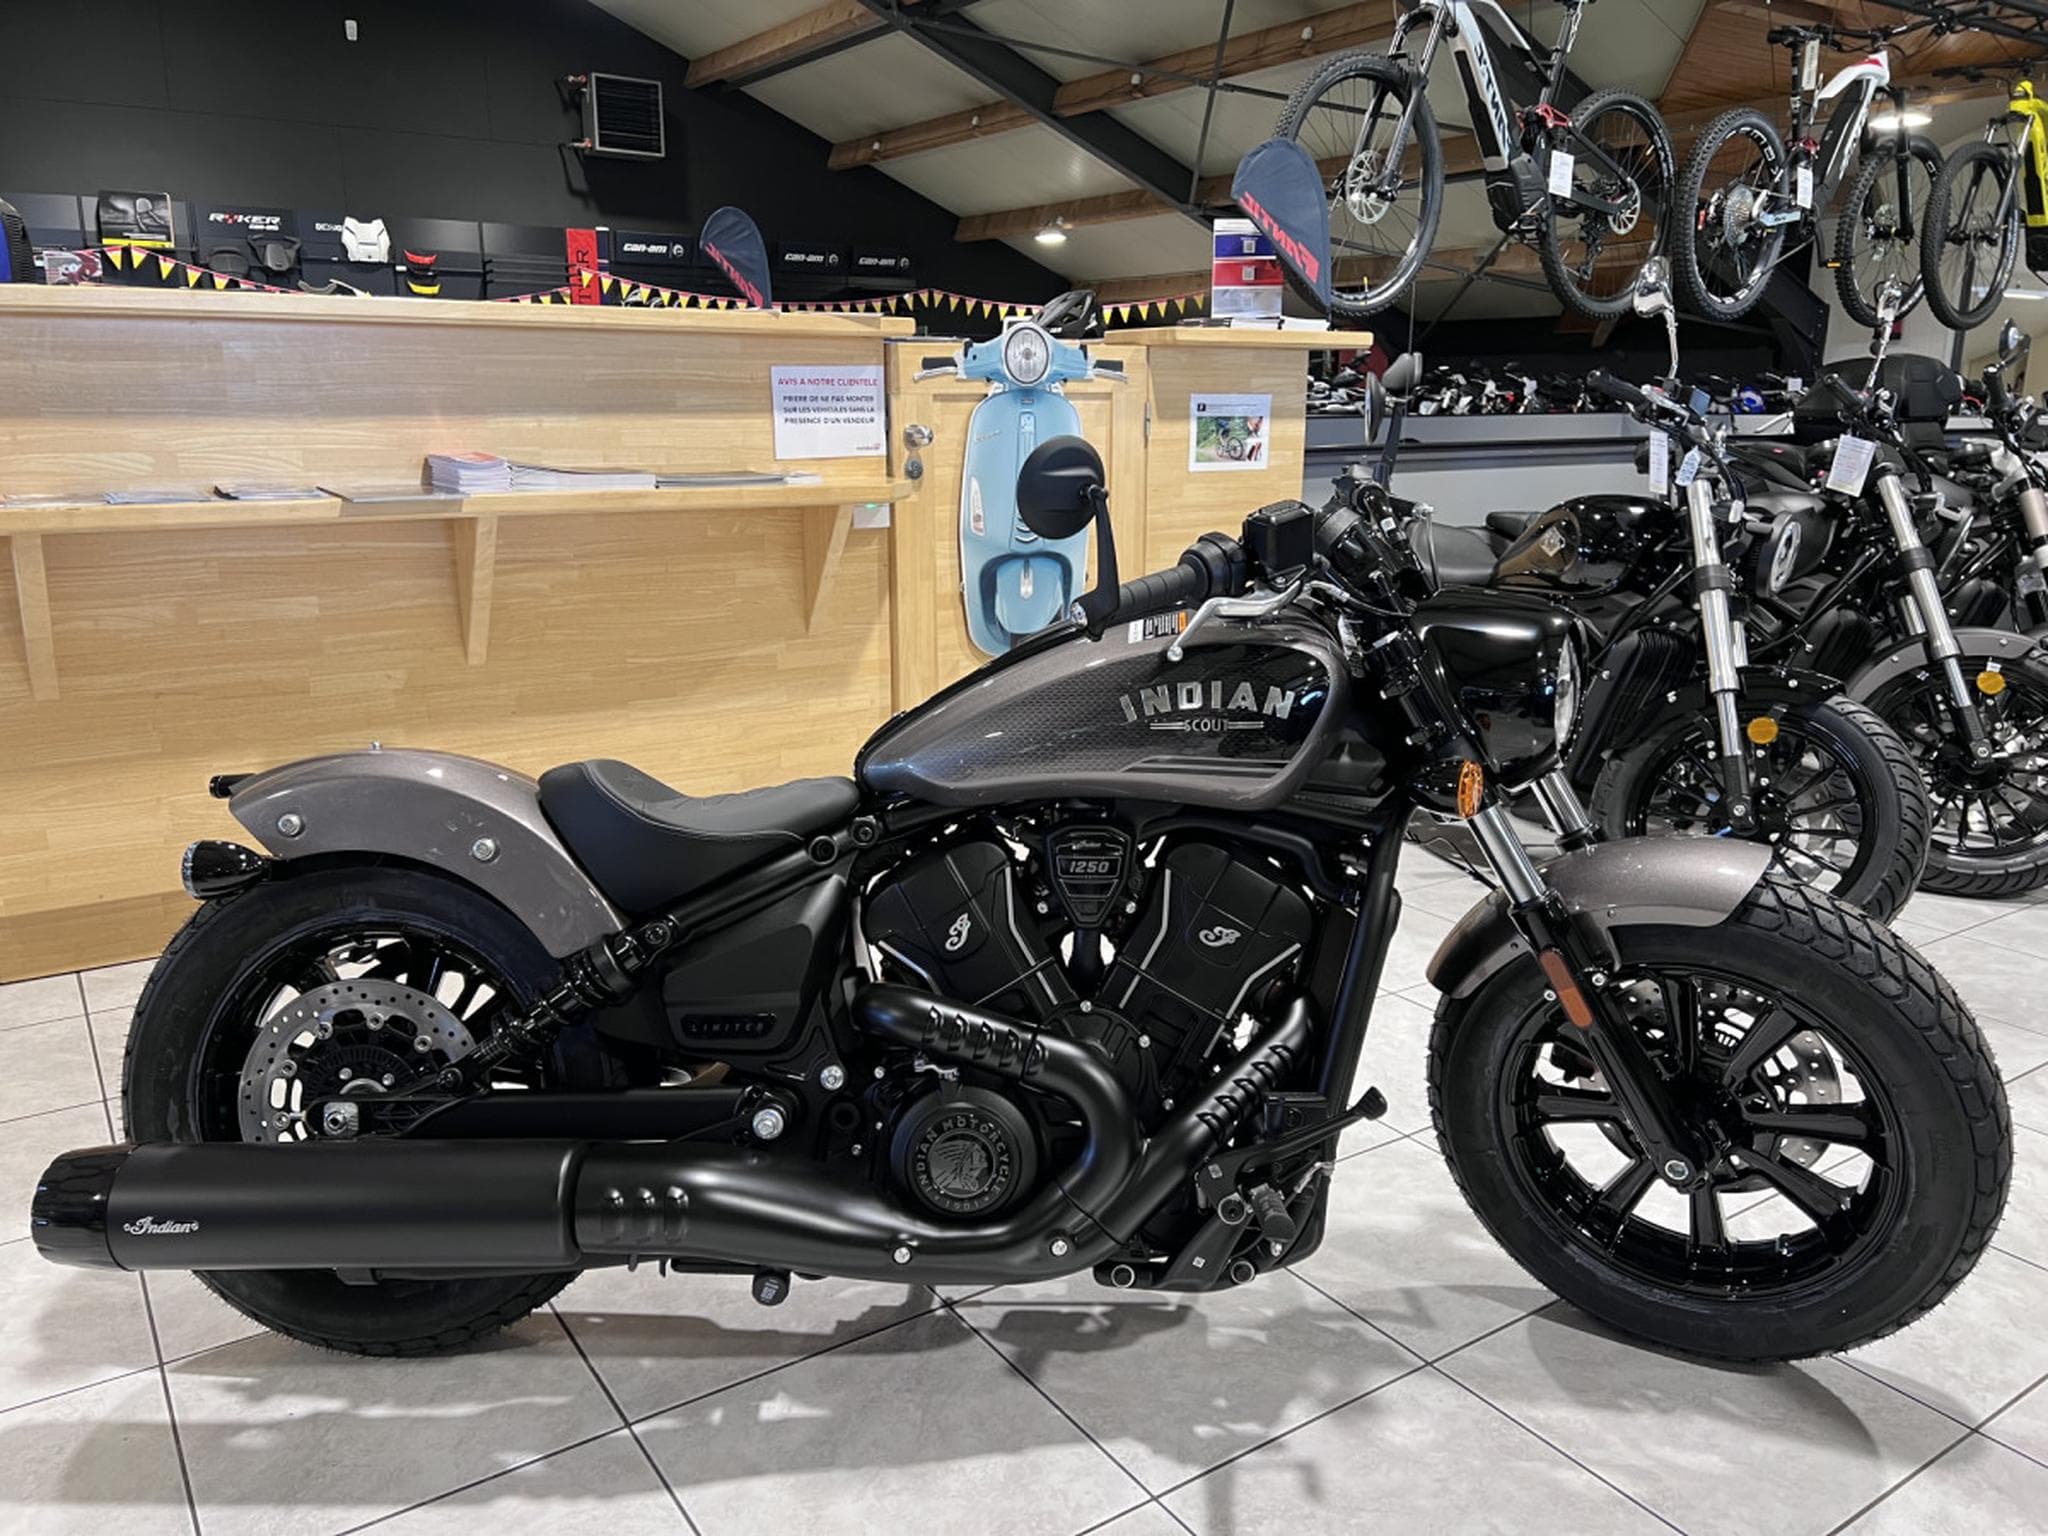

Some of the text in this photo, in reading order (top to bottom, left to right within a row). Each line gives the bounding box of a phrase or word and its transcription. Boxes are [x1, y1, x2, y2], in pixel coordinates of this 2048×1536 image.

[778, 378, 797, 386] AVIS
[807, 378, 835, 386] NOTRE
[837, 378, 878, 387] CLIENTELE
[783, 406, 797, 414] SUR
[1119, 680, 1296, 723] INDIAN
[1184, 718, 1229, 732] SCOUT
[1069, 861, 1110, 873] 1250
[690, 1023, 764, 1032] LIMITED
[916, 1118, 1010, 1194] INDIAN MOTORCYCLE
[129, 1216, 192, 1235] Indian
